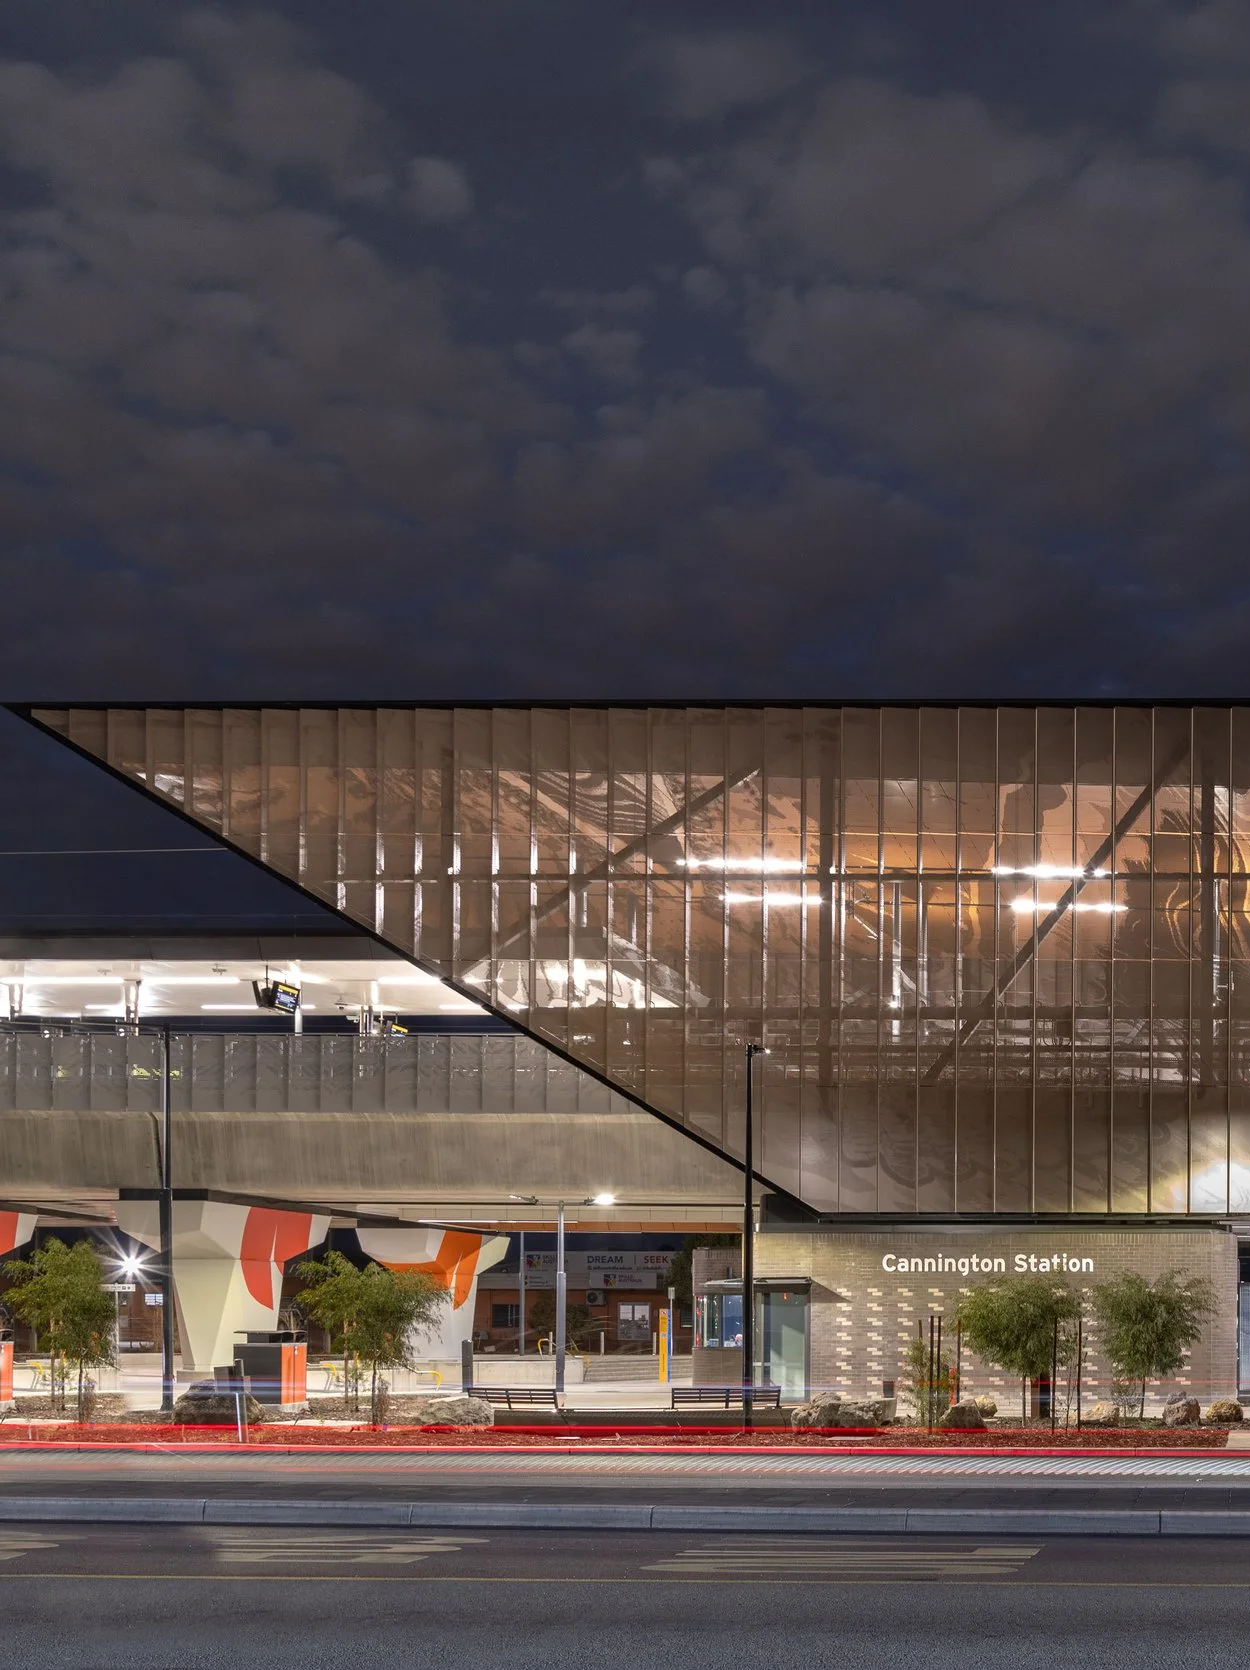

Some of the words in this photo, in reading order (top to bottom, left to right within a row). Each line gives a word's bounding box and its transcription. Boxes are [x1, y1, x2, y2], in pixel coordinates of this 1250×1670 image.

[587, 1255, 624, 1264] DREAM
[643, 1255, 669, 1264] SEEK
[882, 1253, 1006, 1276] Cannington
[1014, 1253, 1094, 1272] Station
